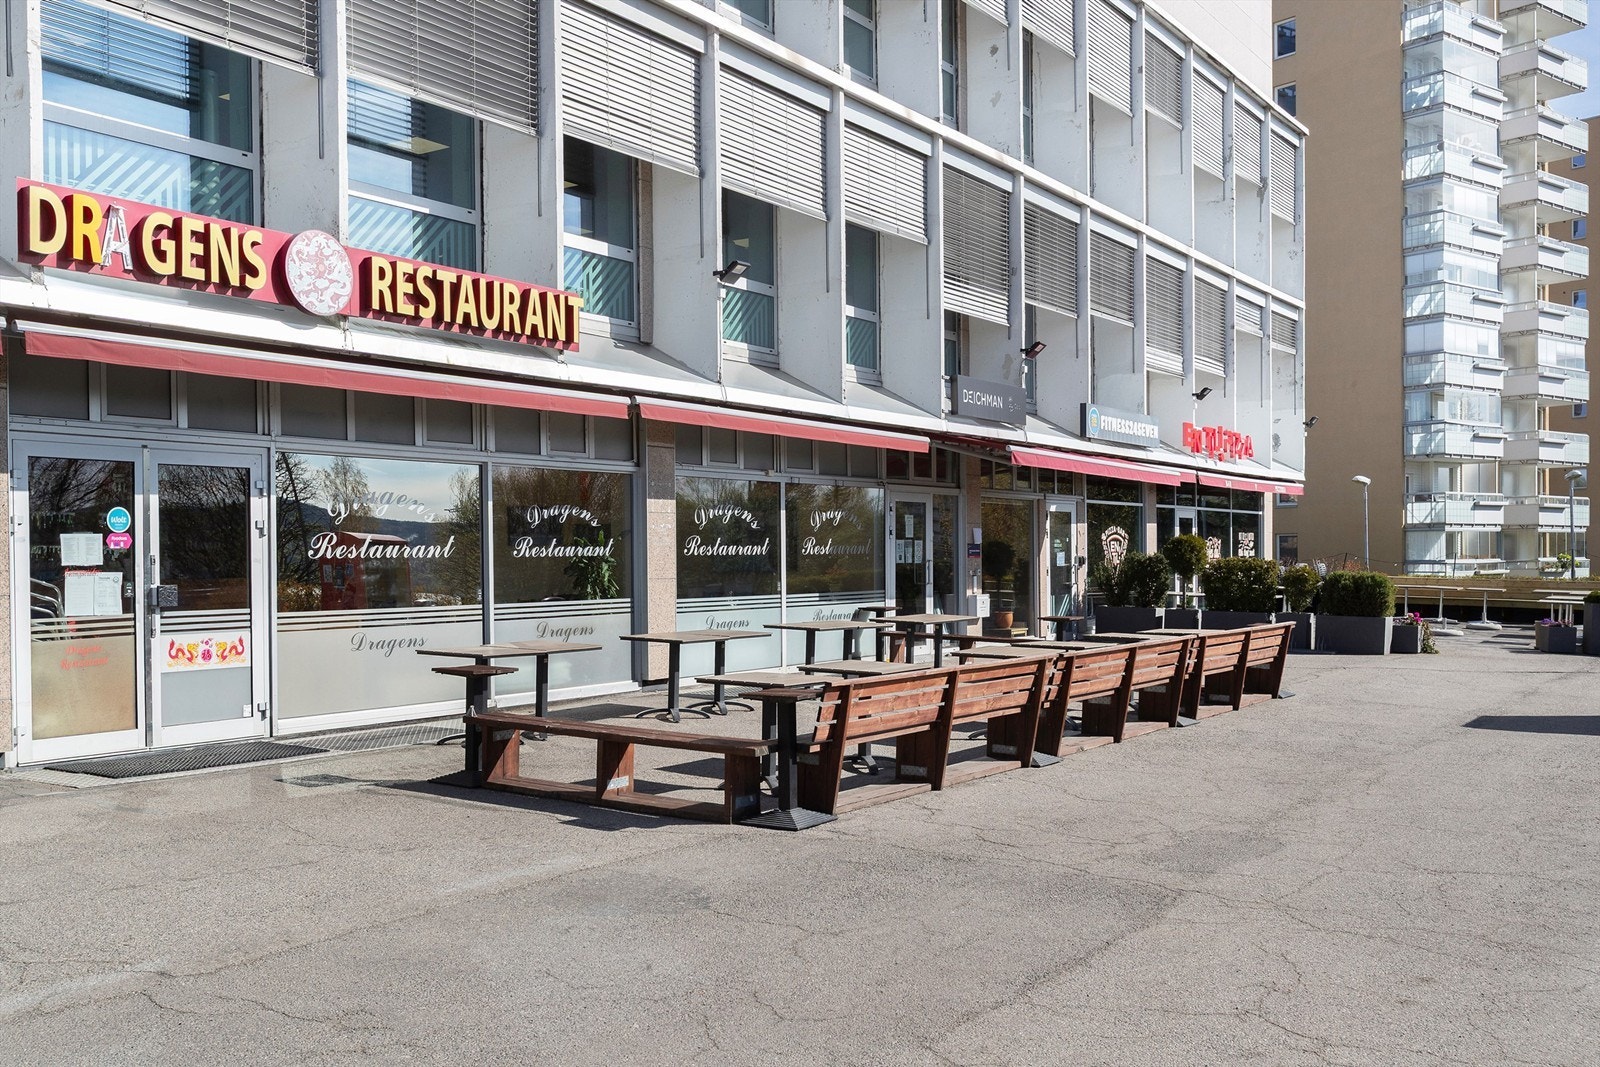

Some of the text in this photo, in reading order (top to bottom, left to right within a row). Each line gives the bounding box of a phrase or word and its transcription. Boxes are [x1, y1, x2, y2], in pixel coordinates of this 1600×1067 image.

[28, 184, 584, 342] DRAGENS RESTAURANT
[963, 389, 1003, 408] DEICHMAN
[1100, 415, 1159, 439] FITNESS24SEVEN
[326, 490, 437, 525] Dragens
[526, 504, 601, 529] Dragens
[694, 503, 761, 530] Dragens
[810, 507, 863, 532] Dragens
[307, 531, 455, 559] Restaurant
[512, 536, 615, 558] Restaurant
[683, 534, 771, 556] Restaurant
[801, 536, 872, 556] Restaurant
[536, 621, 596, 643] Dragens
[705, 614, 751, 631] Dragens
[351, 632, 428, 657] Dragens
